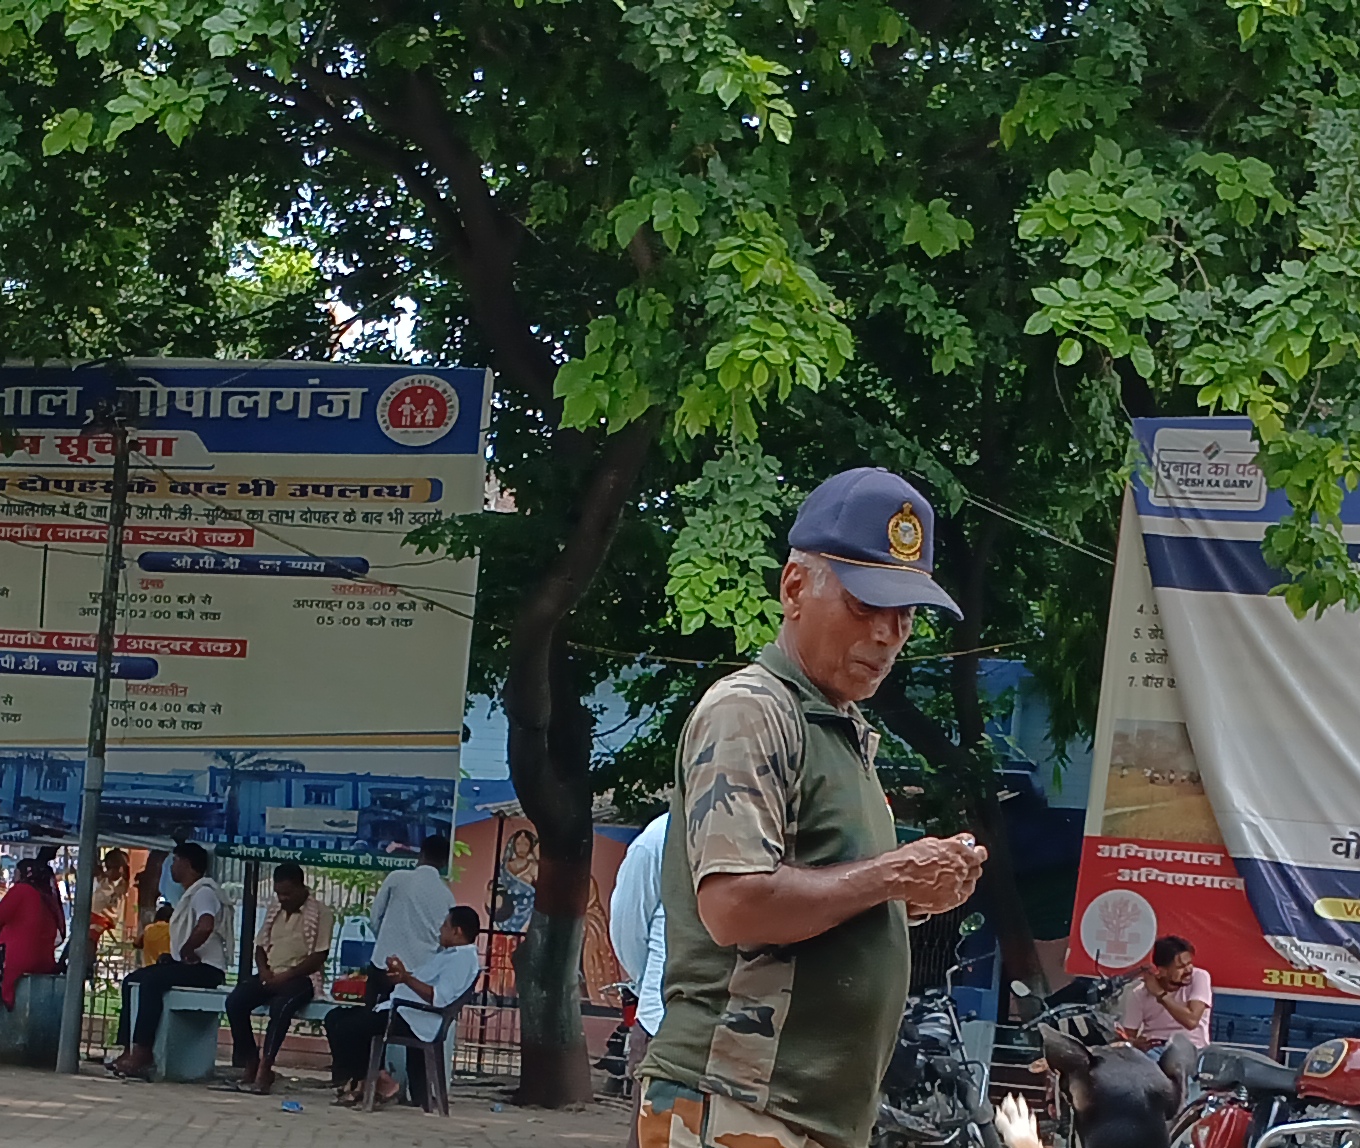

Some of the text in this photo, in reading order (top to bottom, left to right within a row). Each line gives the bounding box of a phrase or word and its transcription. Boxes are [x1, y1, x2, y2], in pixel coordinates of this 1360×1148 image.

[1160, 461, 1231, 479] चुनाव का
[168, 479, 227, 497] बाद
[237, 479, 278, 498] भी
[1177, 479, 1204, 487] DESH
[1223, 480, 1253, 488] GARV
[57, 660, 78, 674] का
